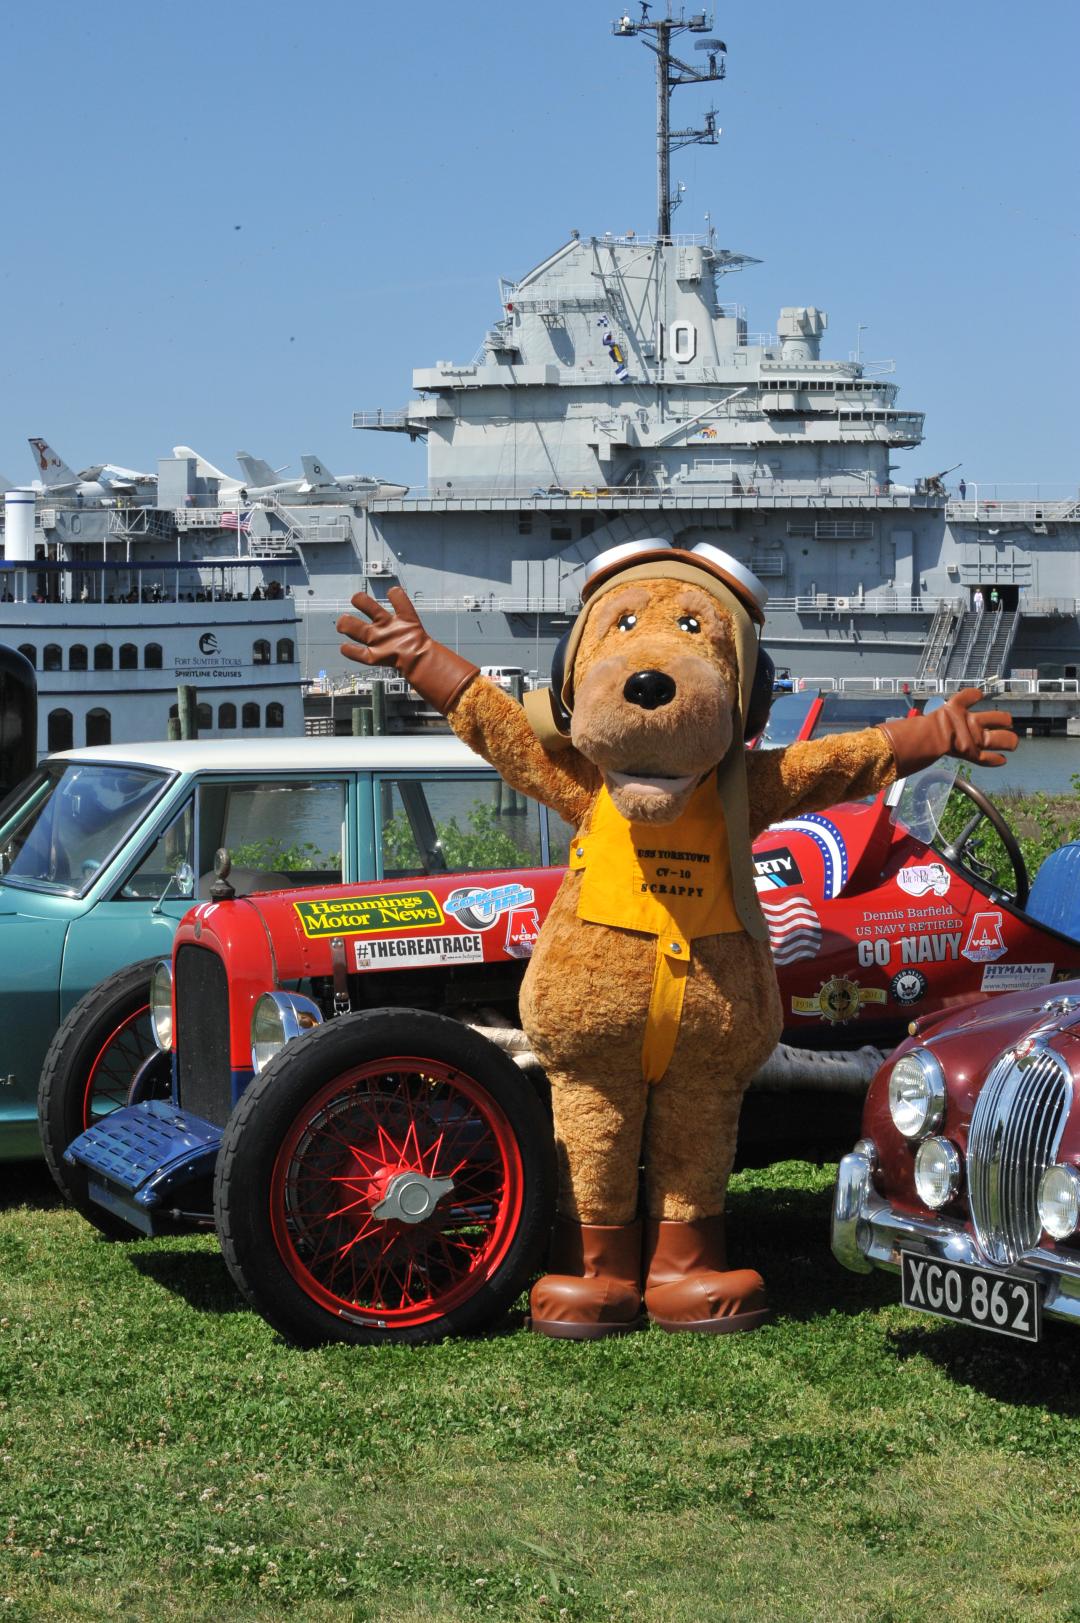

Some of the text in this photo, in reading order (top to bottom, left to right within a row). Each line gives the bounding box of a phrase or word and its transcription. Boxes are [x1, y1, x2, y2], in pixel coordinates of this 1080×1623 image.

[174, 657, 242, 666] FORT SUMTER TOURS
[213, 670, 242, 678] CRUISES
[637, 848, 711, 863] USS YORKTOWN
[656, 867, 691, 879] CV-10
[754, 856, 792, 875] RTY
[445, 884, 522, 913] COKER
[641, 883, 704, 897] SCRAPPY
[308, 894, 423, 915] Hemmings
[479, 890, 533, 916] TIRE
[304, 905, 437, 931] Motor News
[863, 904, 953, 921] Dennis Barfield
[855, 919, 963, 936] US NAVY RETIRED
[356, 935, 481, 959] #THEGREATRACE
[857, 938, 890, 968] GO
[901, 932, 962, 964] NAVY
[986, 965, 1033, 975] HYMAN
[908, 1258, 1030, 1332] XGO 862
